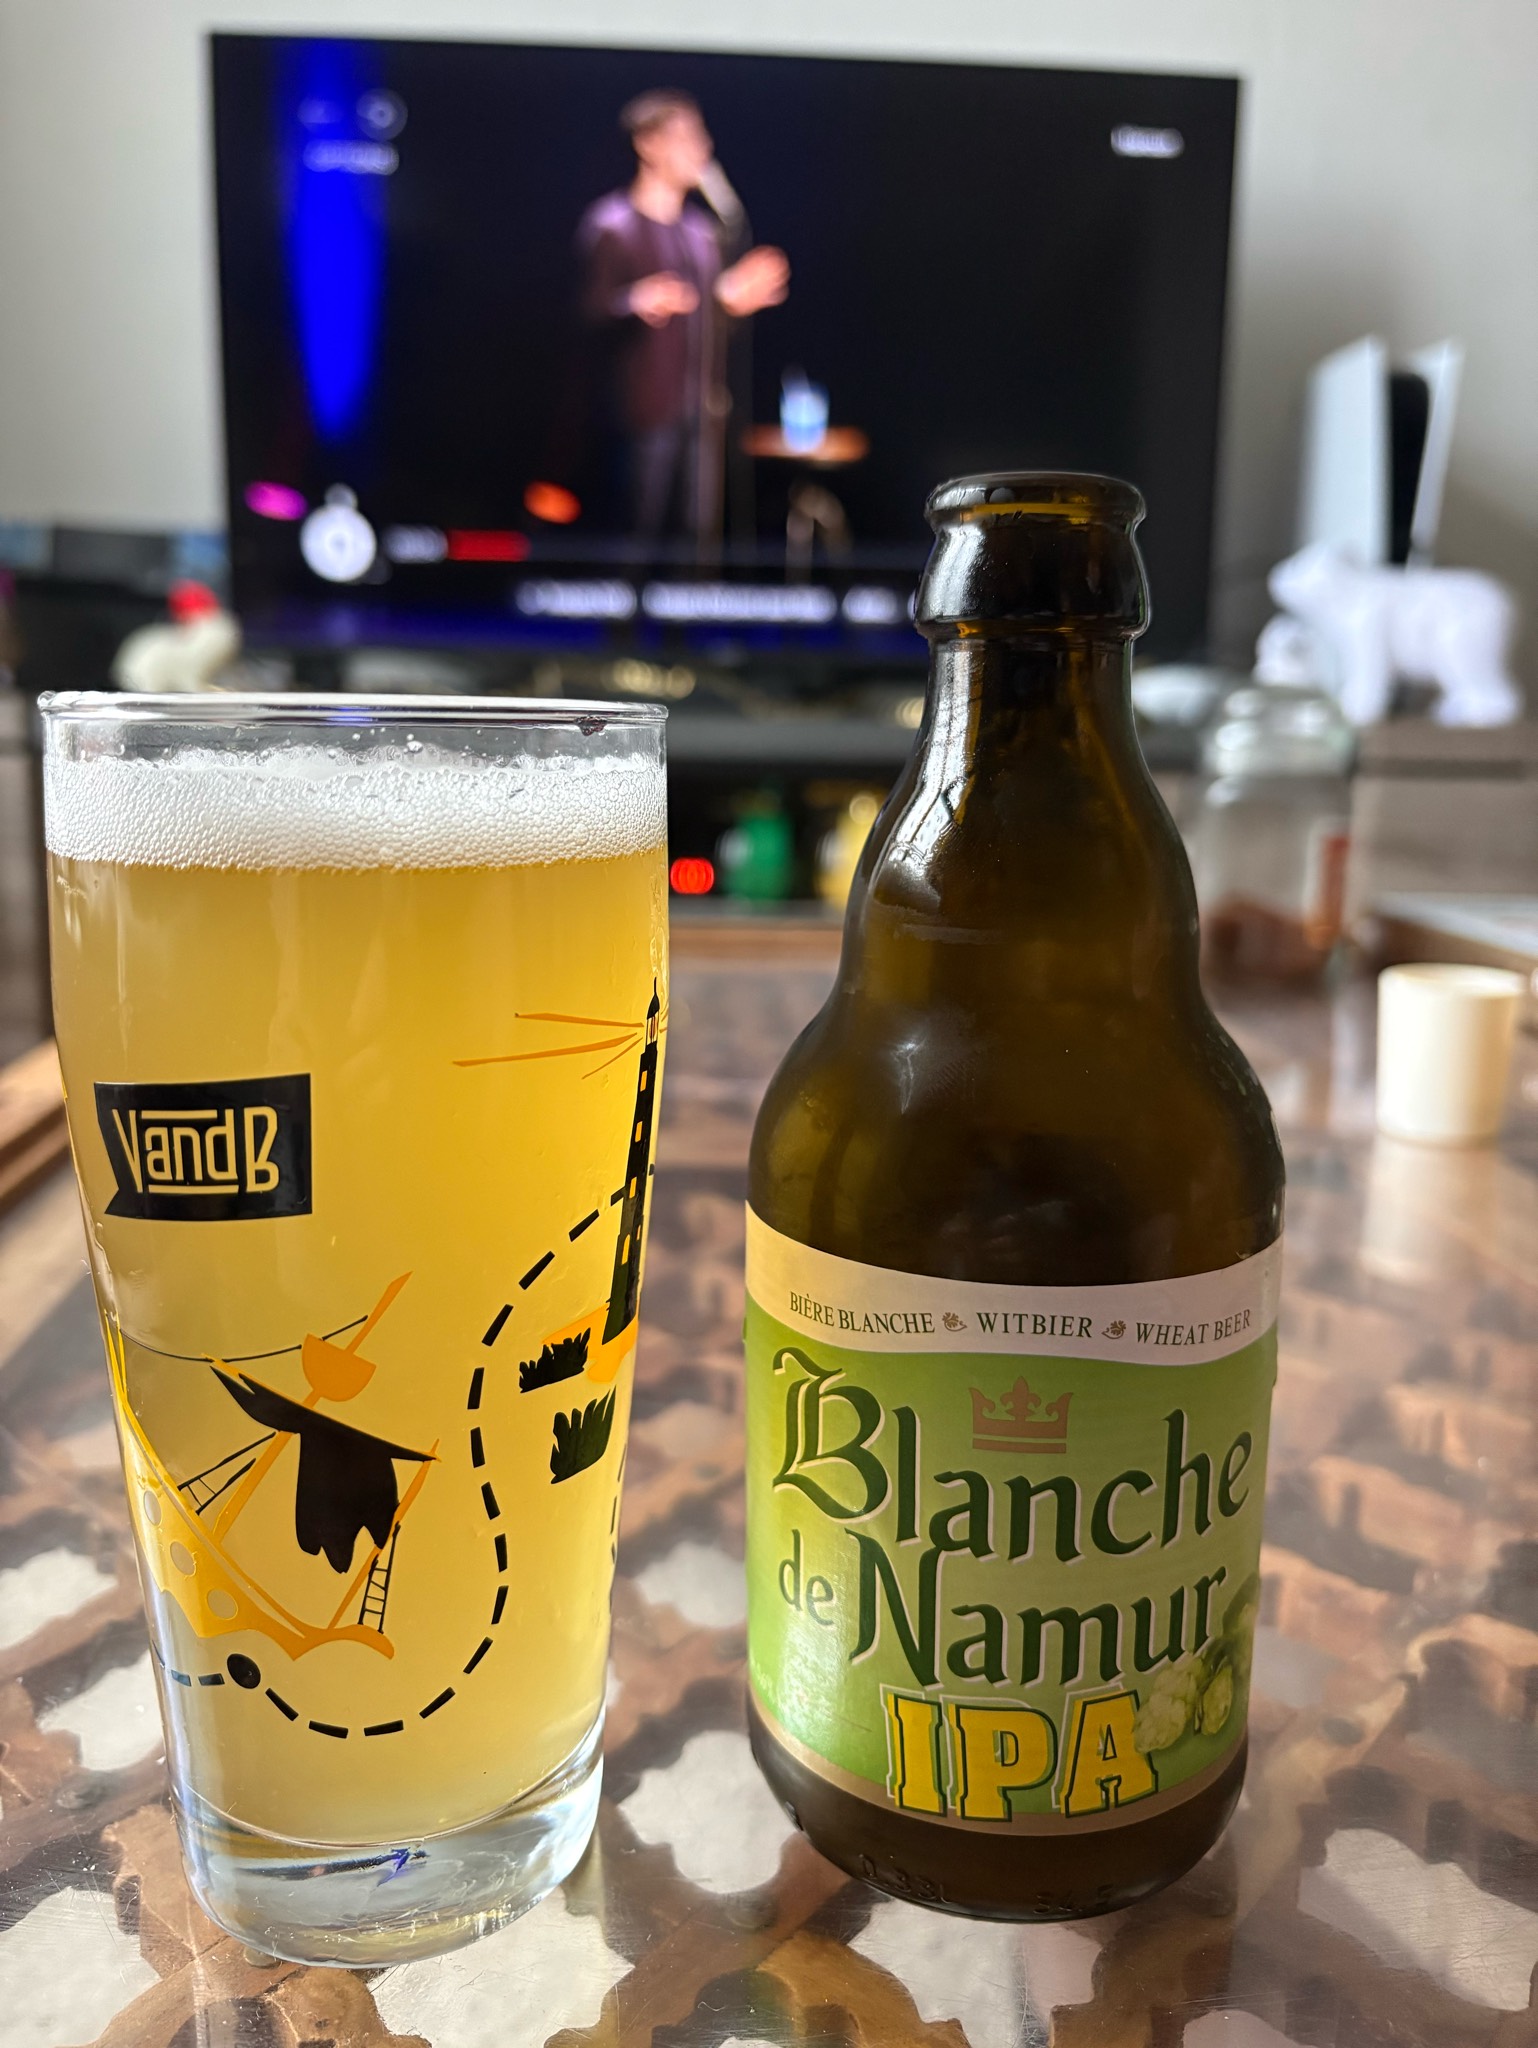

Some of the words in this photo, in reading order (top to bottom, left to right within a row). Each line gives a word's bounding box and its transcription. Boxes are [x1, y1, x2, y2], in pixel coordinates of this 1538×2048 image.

[790, 1291, 834, 1328] BIÈRE
[838, 1308, 936, 1334] BLANCHE
[977, 1311, 1093, 1338] WITBIER
[1135, 1322, 1210, 1347] WHEAT
[1213, 1308, 1252, 1341] BEER
[772, 1346, 1254, 1564] Blanche
[778, 1528, 835, 1627] de
[845, 1527, 1228, 1688] Namur
[880, 1683, 1159, 1822] IPA
